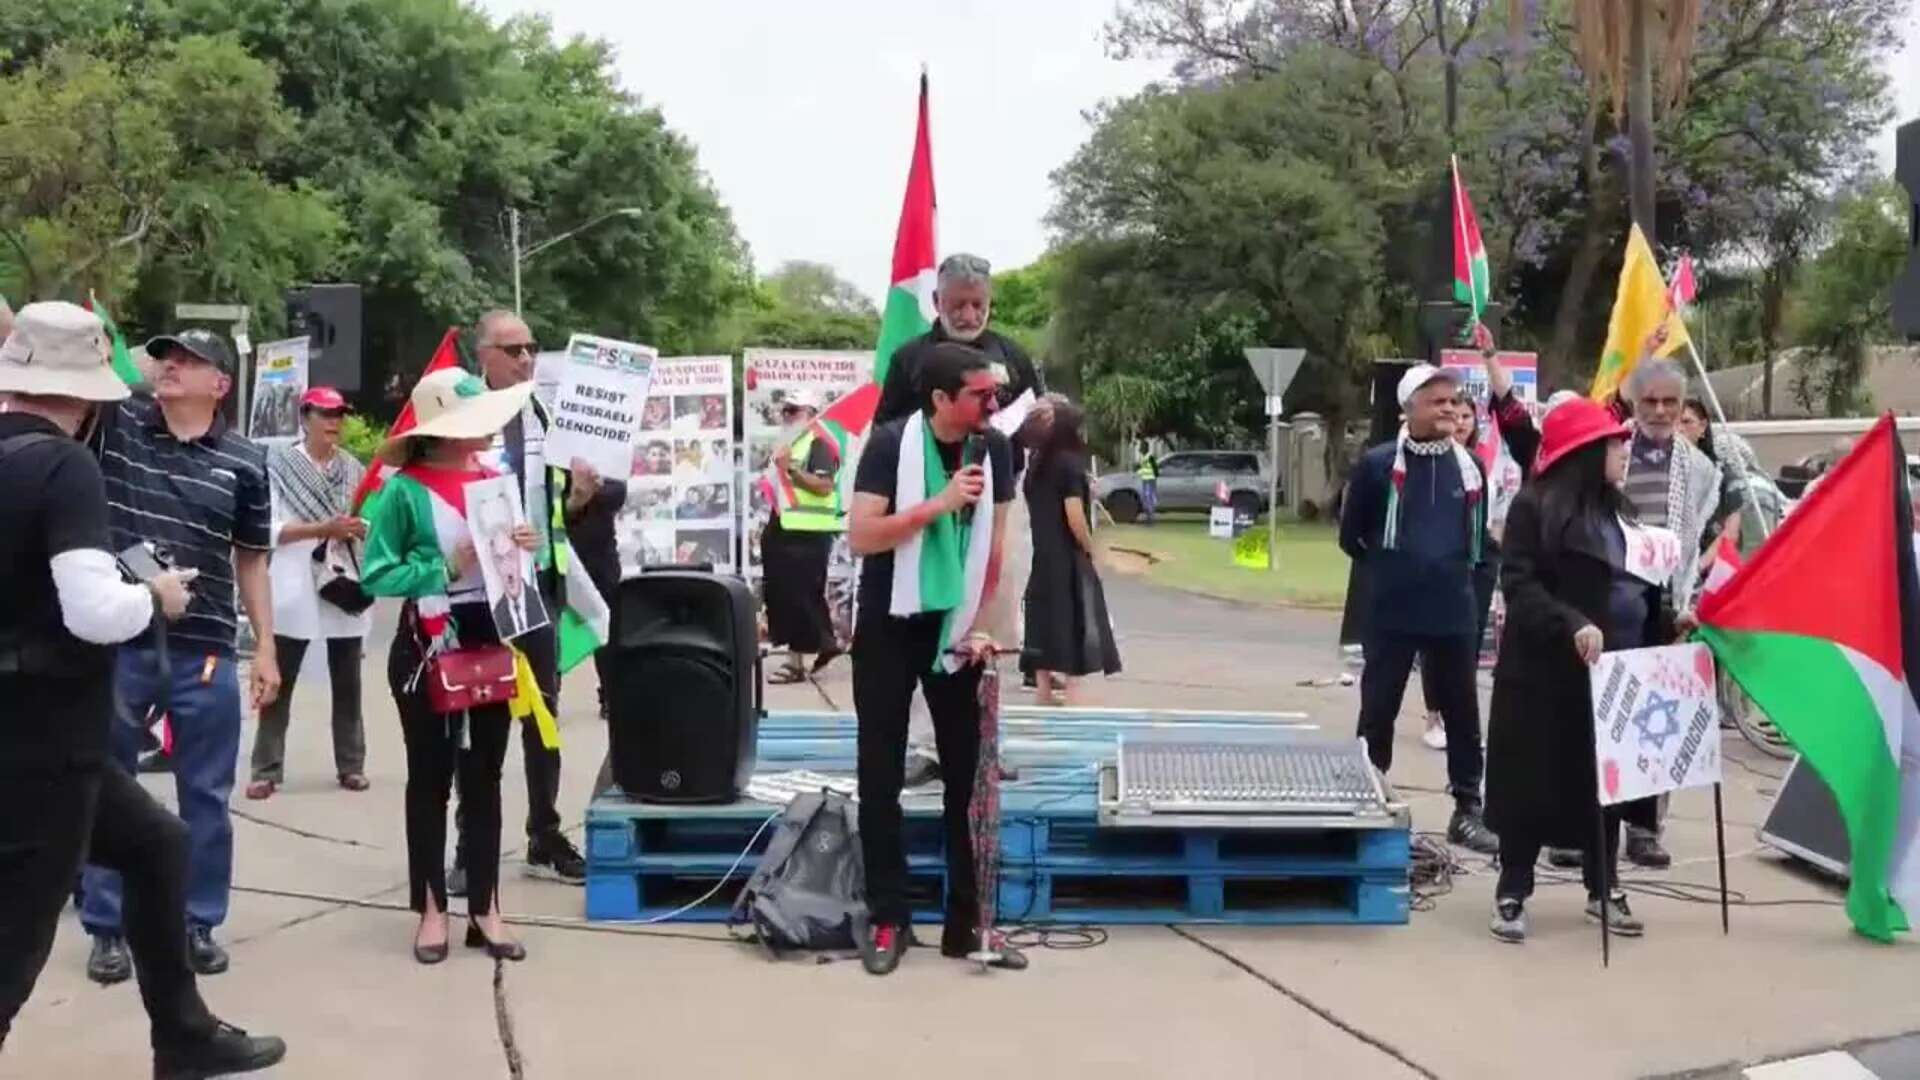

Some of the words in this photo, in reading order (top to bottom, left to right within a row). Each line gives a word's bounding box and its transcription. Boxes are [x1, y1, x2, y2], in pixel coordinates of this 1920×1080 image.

[791, 360, 857, 372] GENOCIDE
[576, 384, 627, 404] RESIST
[555, 417, 632, 442] GENOCIDE!
[1610, 673, 1642, 744] CHILDREN
[1669, 701, 1714, 785] GENOCIDE
[1637, 753, 1650, 774] IS
